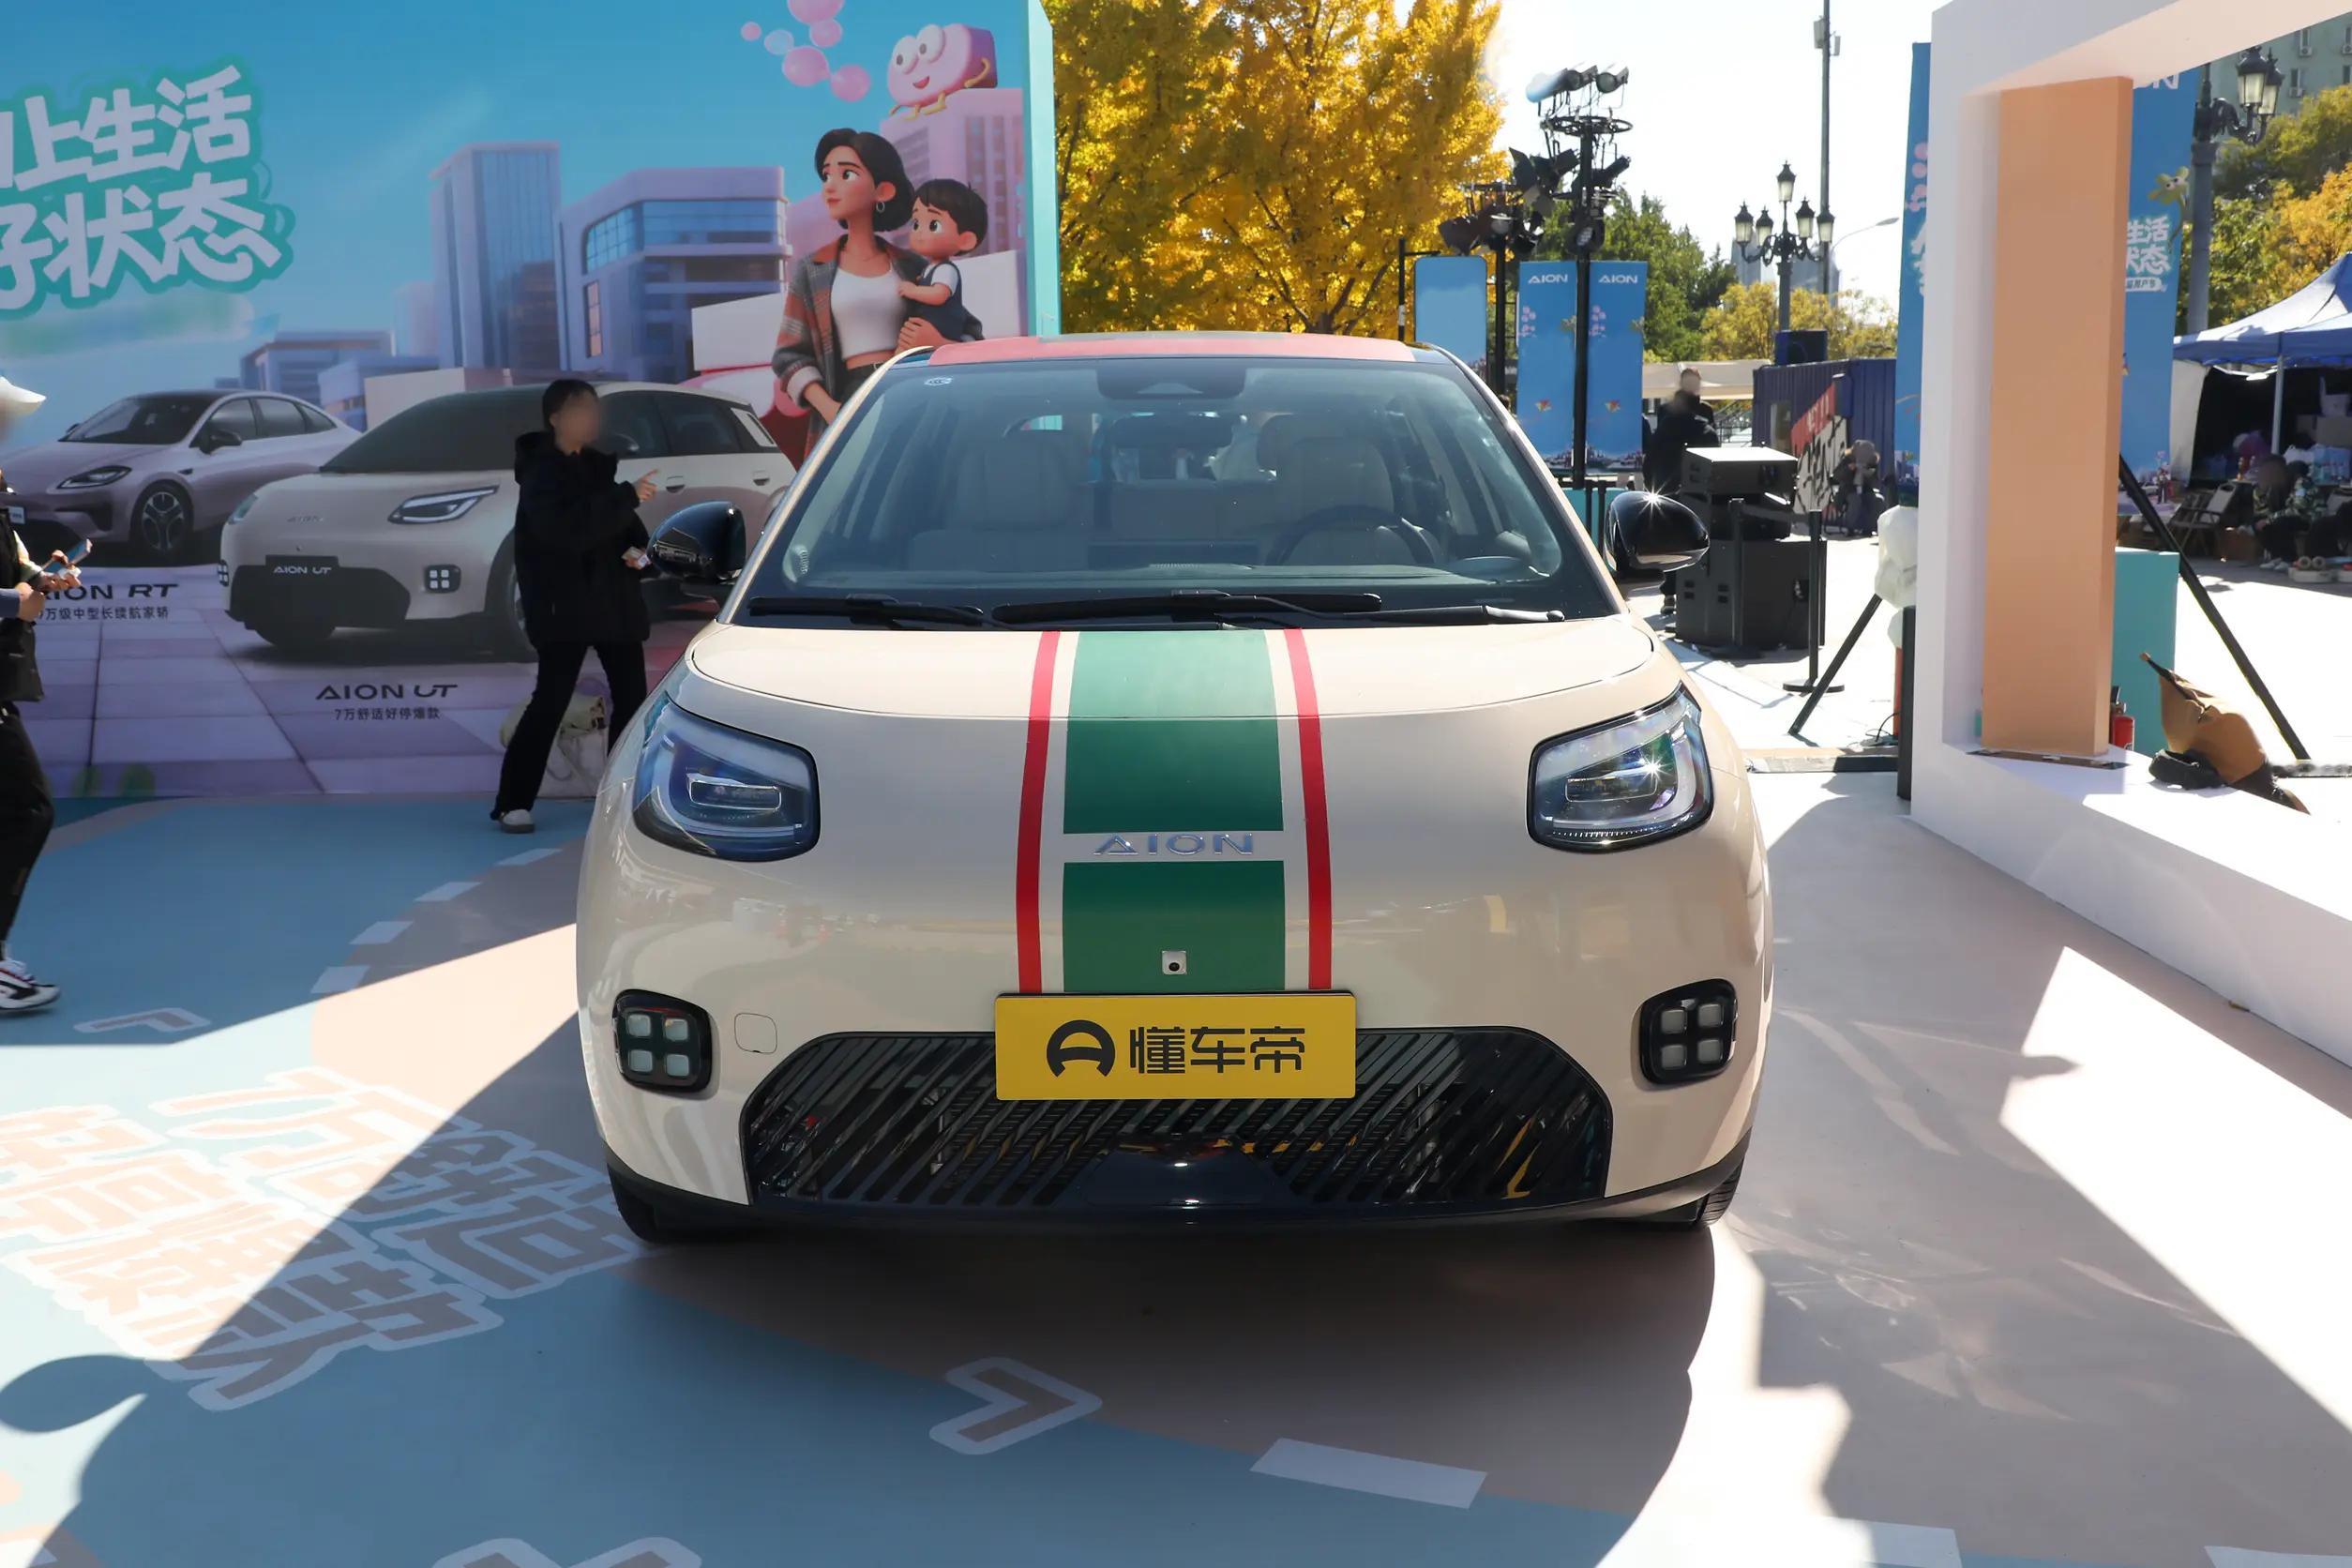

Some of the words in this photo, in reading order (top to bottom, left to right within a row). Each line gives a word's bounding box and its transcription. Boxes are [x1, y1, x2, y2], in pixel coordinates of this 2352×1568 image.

[0, 65, 251, 191] 上生活
[1528, 274, 1568, 284] AION
[1598, 274, 1638, 284] AION
[274, 565, 308, 574] AION
[312, 565, 332, 575] UT
[46, 585, 113, 600] ION
[128, 583, 178, 598] RT
[39, 606, 168, 620] 万级中型长续航家轿
[316, 684, 403, 700] AION
[414, 684, 459, 698] UT
[334, 707, 440, 720] 7万舒适好停爆款
[1093, 833, 1254, 855] AION
[1129, 1026, 1305, 1074] 懂车帝
